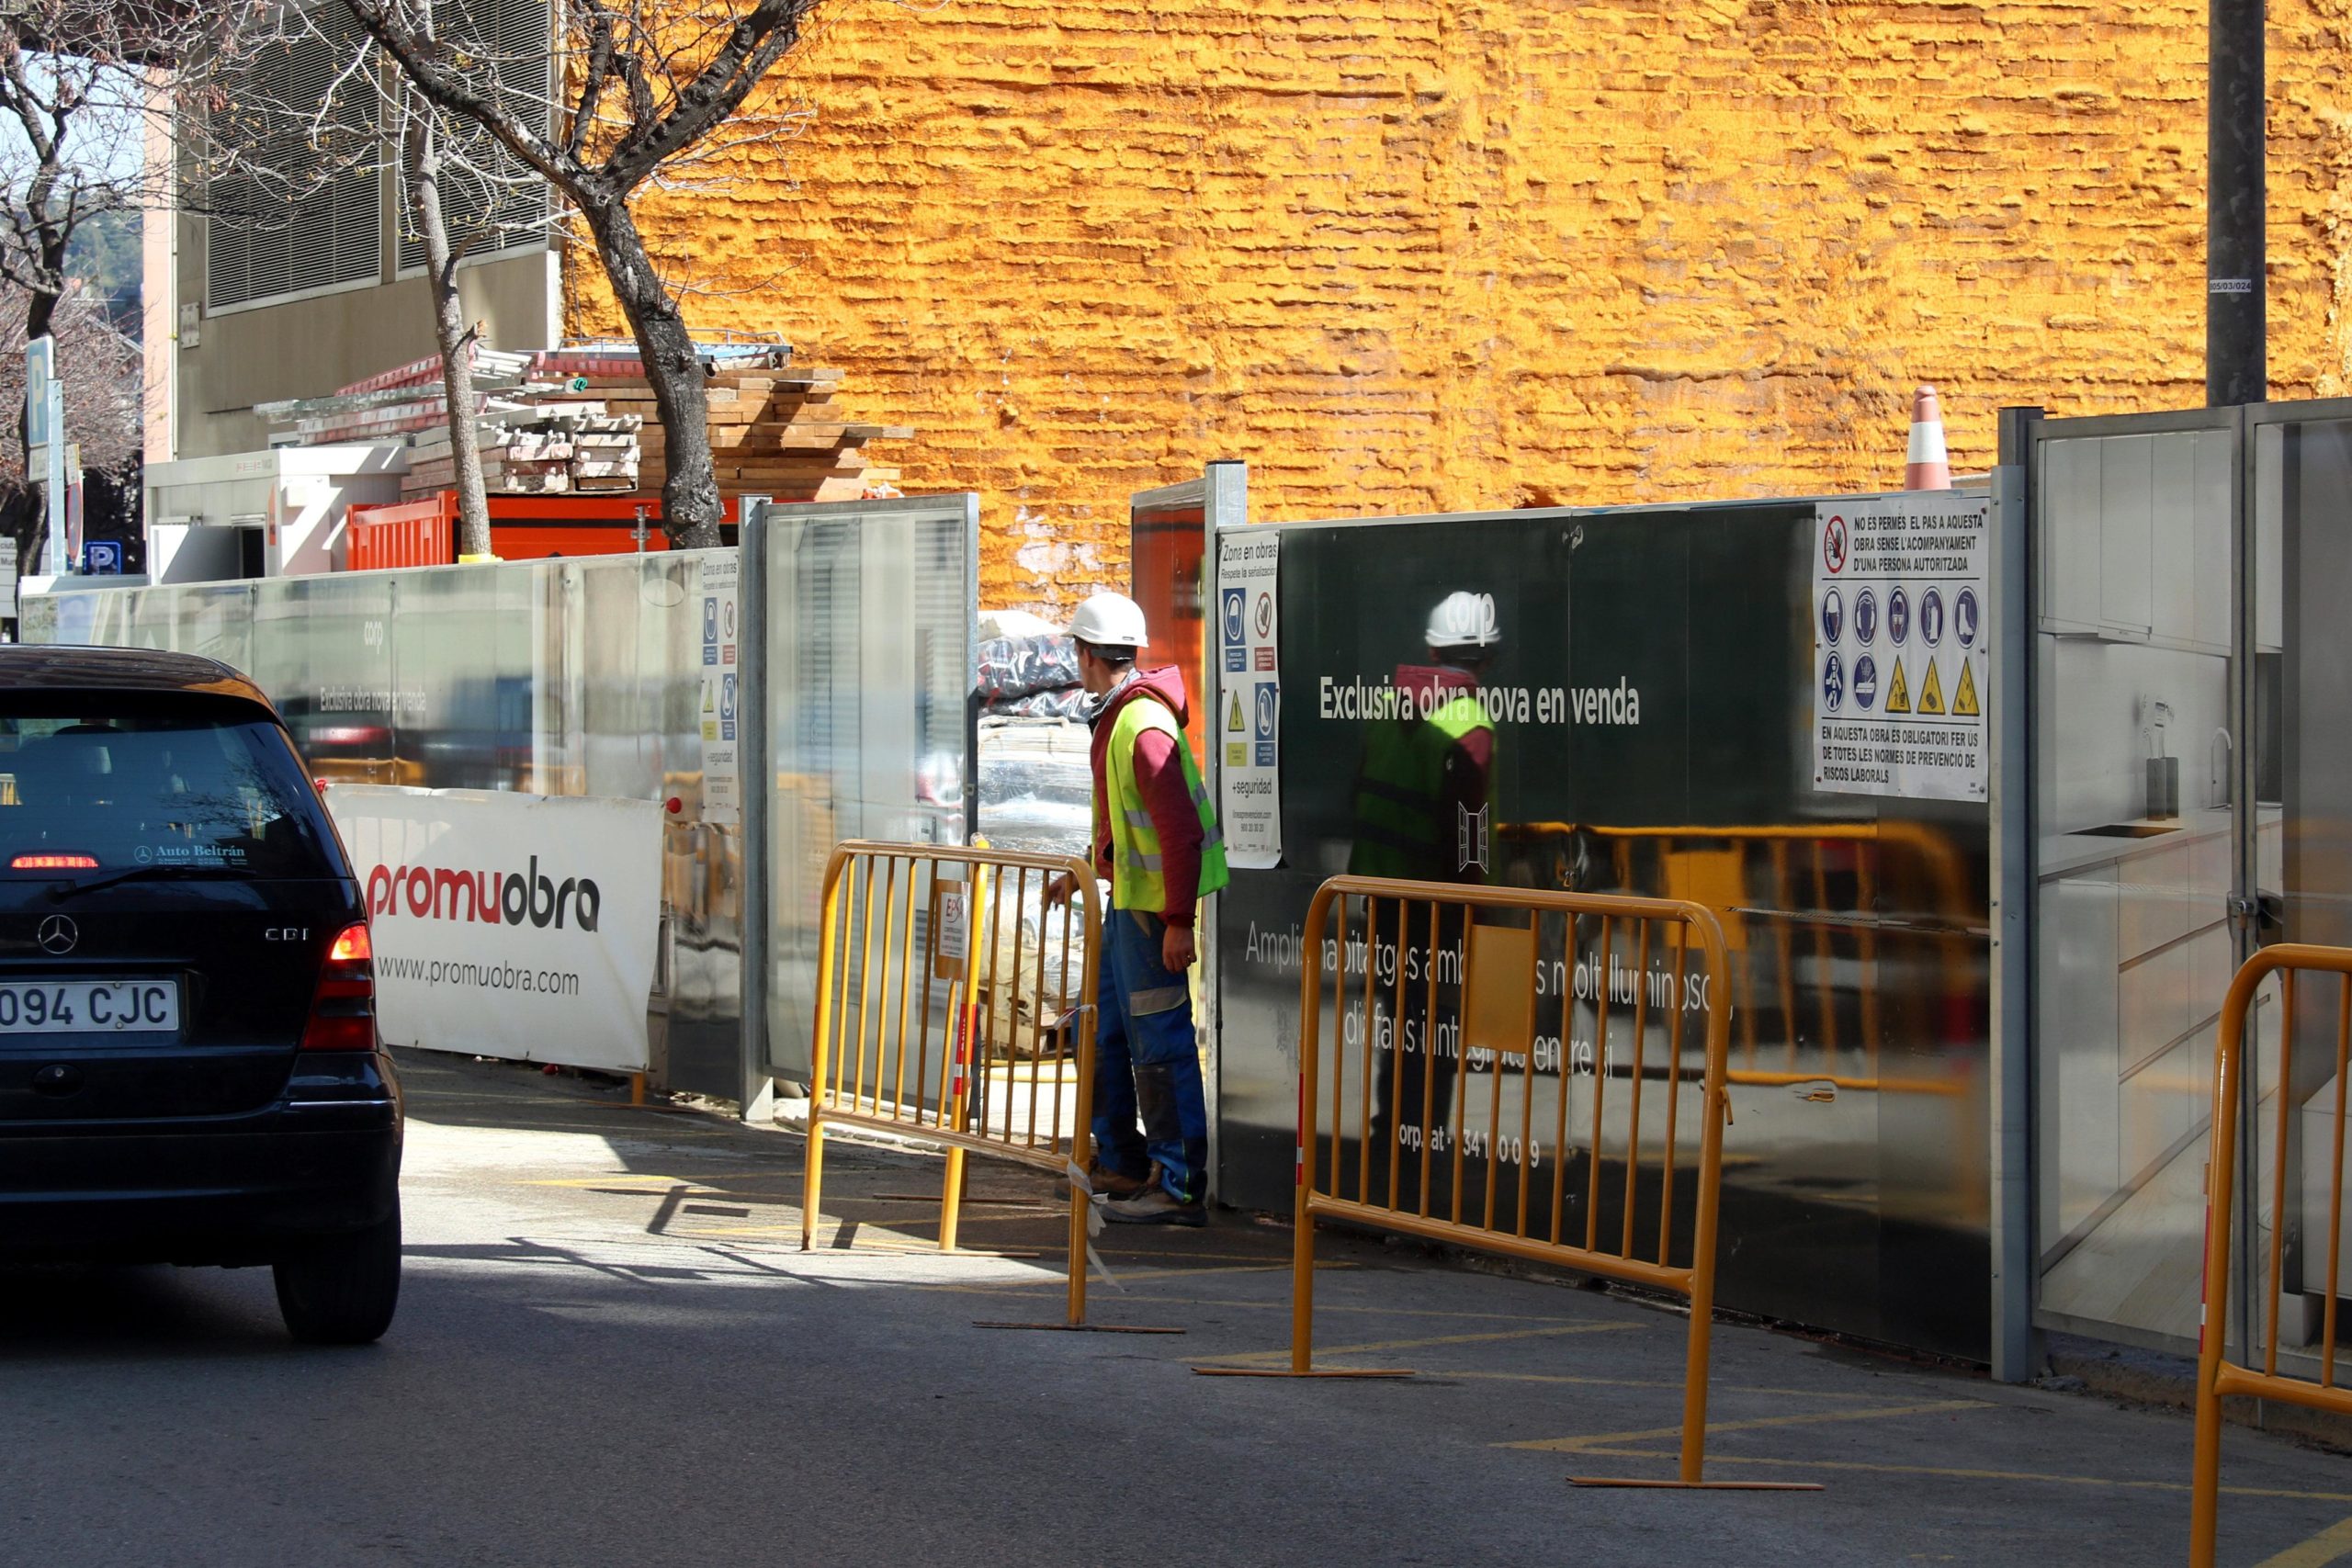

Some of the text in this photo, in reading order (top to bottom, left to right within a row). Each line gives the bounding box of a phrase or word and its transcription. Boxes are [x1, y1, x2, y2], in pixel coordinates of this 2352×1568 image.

[31, 355, 44, 432] P
[1854, 517, 1866, 530] NO
[1910, 516, 1920, 530] EL
[1922, 515, 1937, 529] PAS
[1939, 515, 1945, 529] A
[1947, 514, 1983, 529] AQUESTA
[1223, 541, 1277, 562] Zona en obras
[1854, 536, 1976, 551] OBRA SENSE L'ACOMPANYAMENT
[90, 546, 114, 575] P
[1242, 567, 1248, 578] la
[1854, 557, 1968, 571] D'UNA PERSONA AUTORITZADA
[1447, 592, 1496, 647] corp
[364, 621, 383, 654] corp
[320, 686, 353, 711] Exclusiva
[354, 685, 371, 711] obra
[372, 691, 390, 711] nova
[1320, 675, 1640, 725] Exclusiva obra nova en venda
[1823, 726, 1832, 739] EN
[1834, 727, 1868, 741] AQUESTA
[1870, 728, 1890, 743] OBRA
[1903, 729, 1949, 746] OBLIGATORI
[1951, 732, 1965, 747] FER
[1823, 746, 1975, 768] DE TOTES LES NORMES DE PREVENCIÓ DE
[1233, 778, 1272, 798] +seguridad
[1824, 766, 1889, 784] RISCOS LABORALS
[156, 845, 245, 857] Auto Beltrán
[367, 855, 600, 932] promuobra
[379, 956, 579, 995] www.promuobra.com
[89, 987, 166, 1024] CJC
[1533, 1035, 1590, 1076] enre
[1483, 1132, 1508, 1163] 10
[1512, 1137, 1540, 1168] 09
